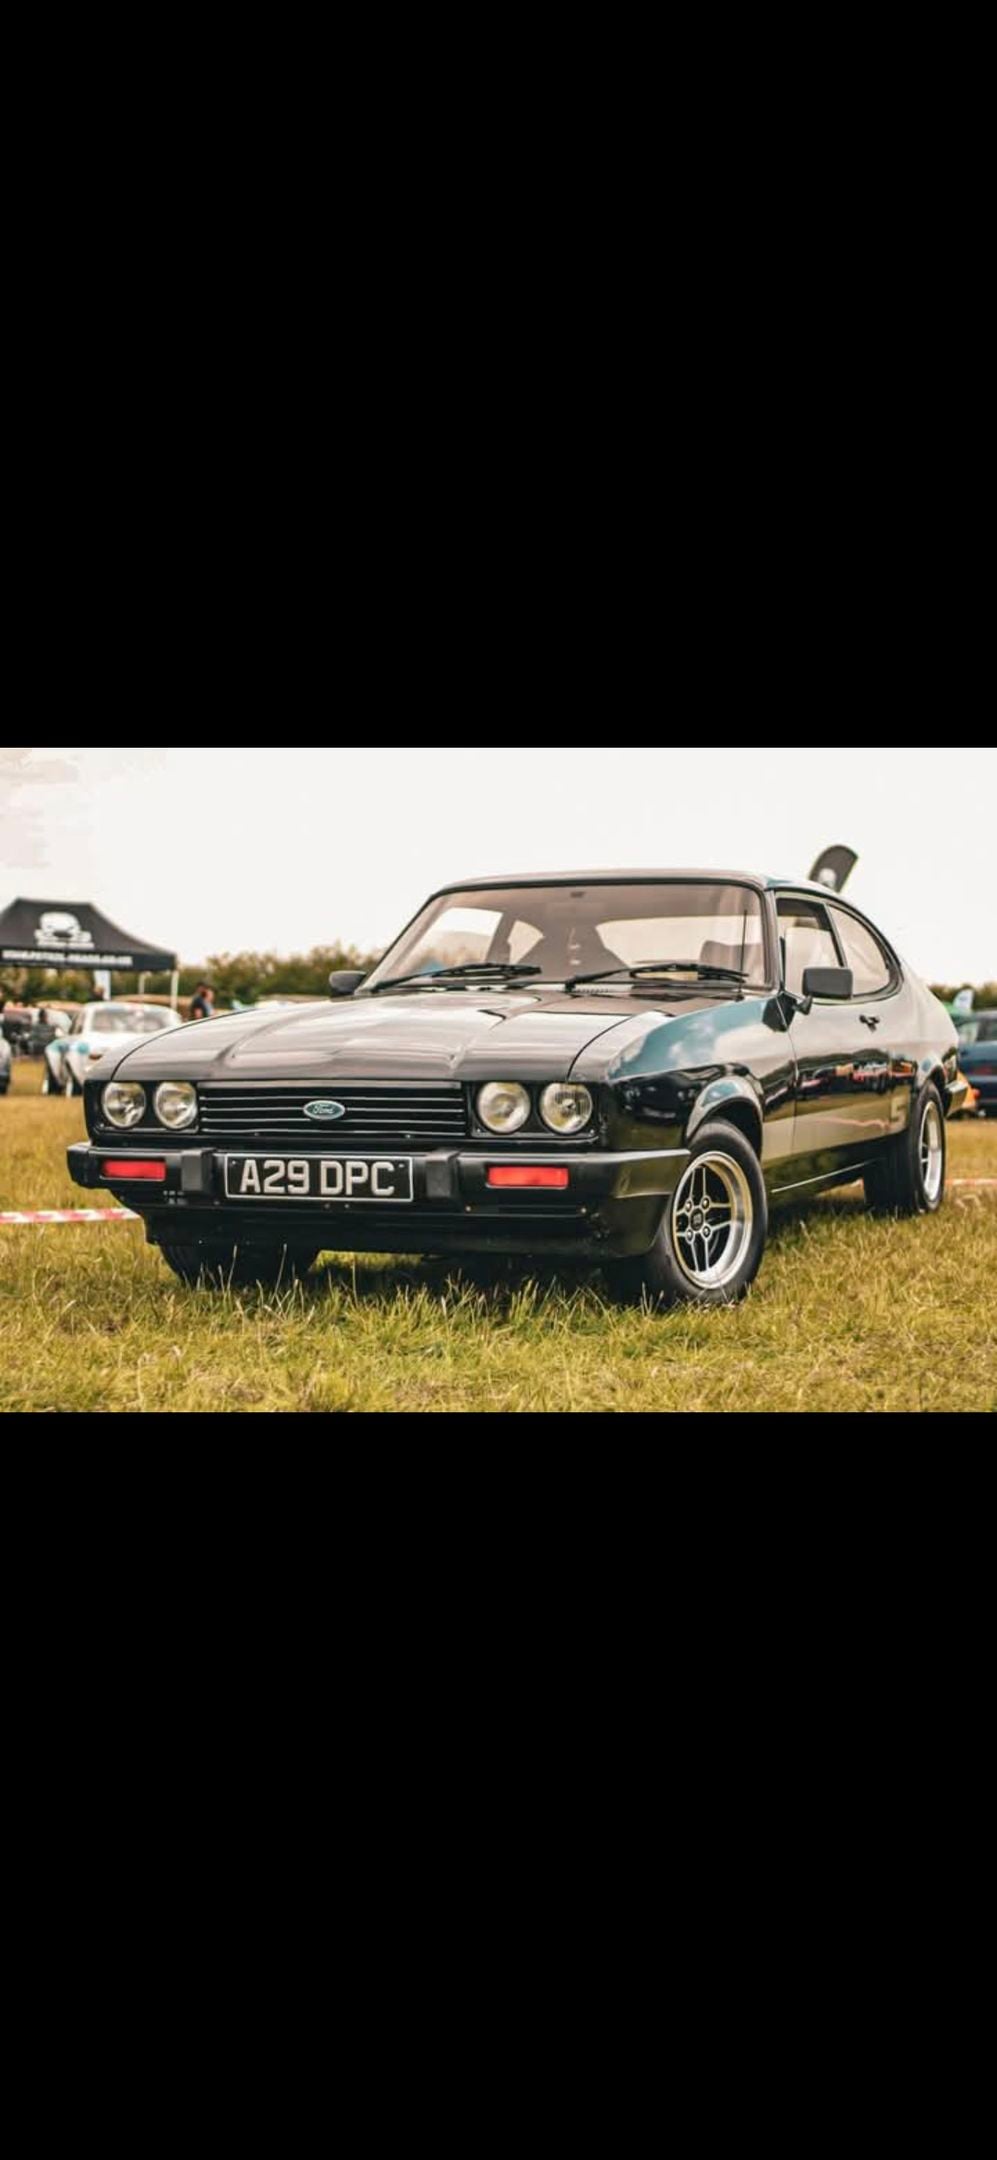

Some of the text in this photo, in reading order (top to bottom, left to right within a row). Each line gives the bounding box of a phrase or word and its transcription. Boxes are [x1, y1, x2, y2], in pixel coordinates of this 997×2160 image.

[312, 1103, 336, 1114] Ford
[240, 1159, 395, 1196] A29 DPC
